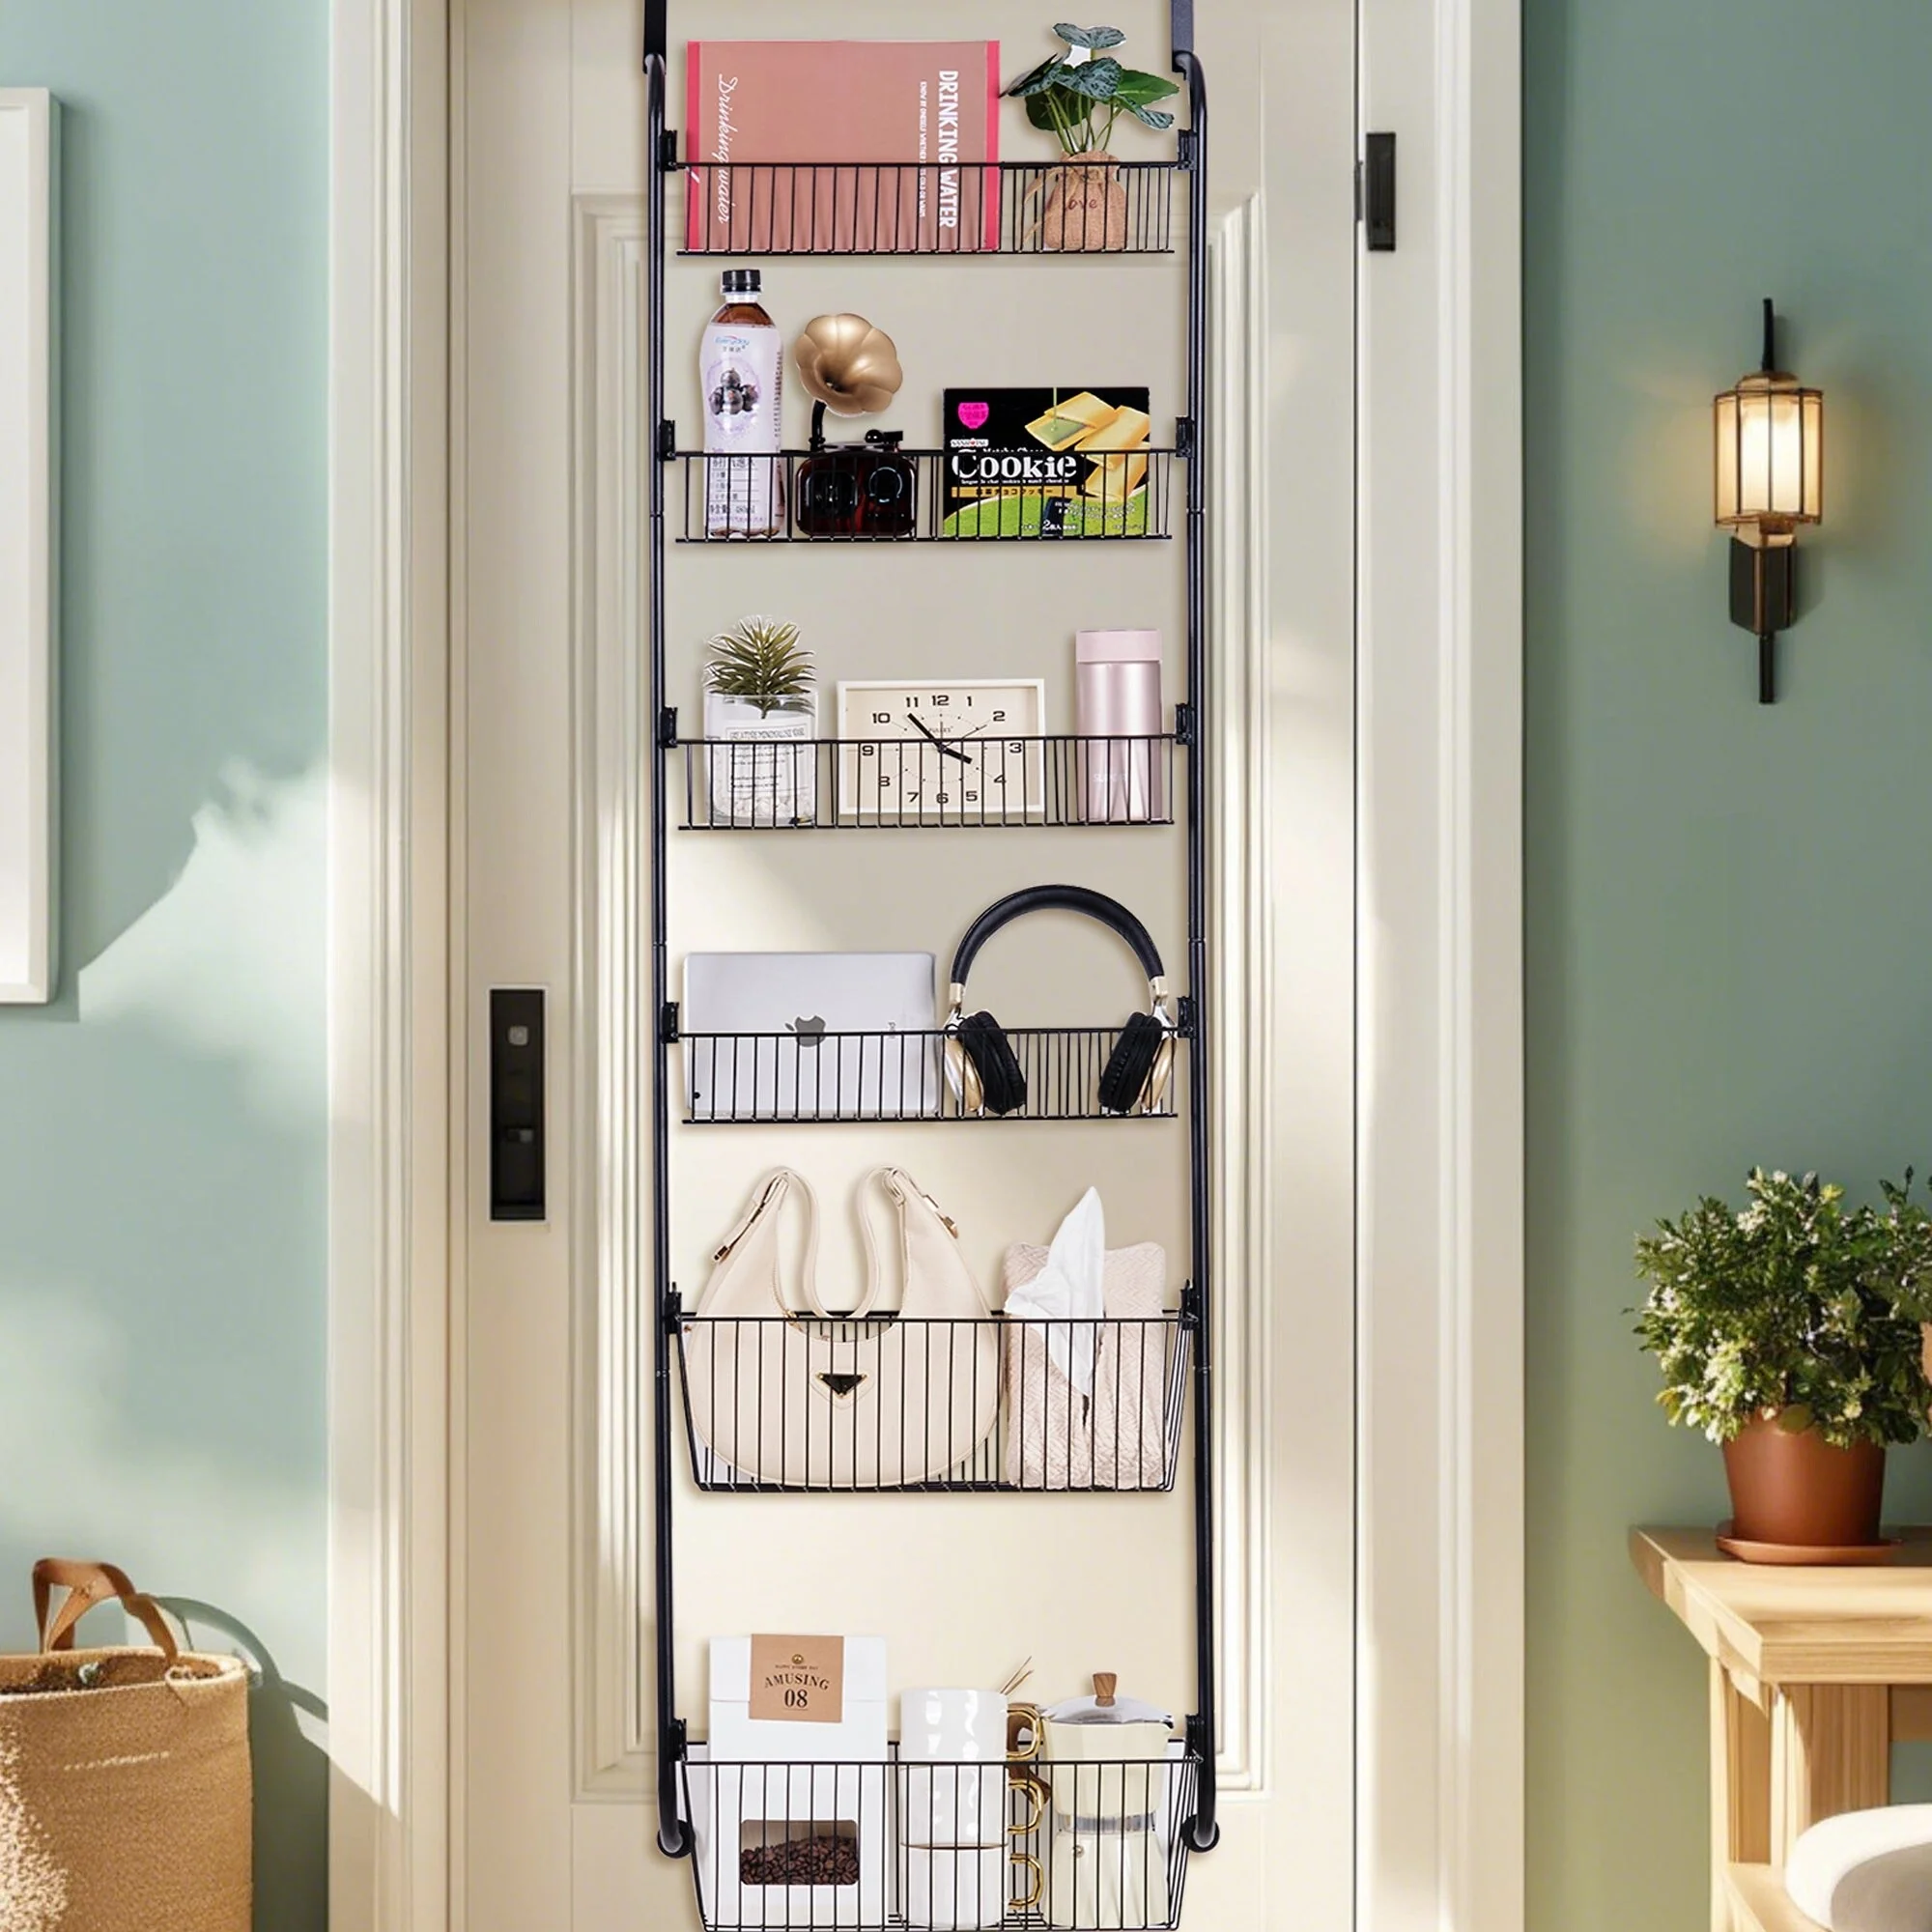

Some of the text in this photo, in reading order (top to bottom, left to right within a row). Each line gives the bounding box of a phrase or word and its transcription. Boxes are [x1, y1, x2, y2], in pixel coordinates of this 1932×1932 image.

[711, 73, 738, 163] Drinking
[939, 71, 958, 228] DRINKING WATER
[952, 449, 1077, 478] Cookie
[906, 696, 919, 708] 11
[931, 695, 950, 706] 12
[967, 696, 973, 707] 1
[872, 713, 891, 724] 10
[992, 711, 1006, 722] 2
[862, 745, 874, 756] 9
[1009, 742, 1022, 753] 3
[993, 774, 1007, 784] 4
[907, 792, 920, 803] 7
[936, 792, 949, 804] 6
[966, 791, 978, 802] 5
[765, 1672, 830, 1690] AMUSING
[784, 1689, 808, 1708] 08
